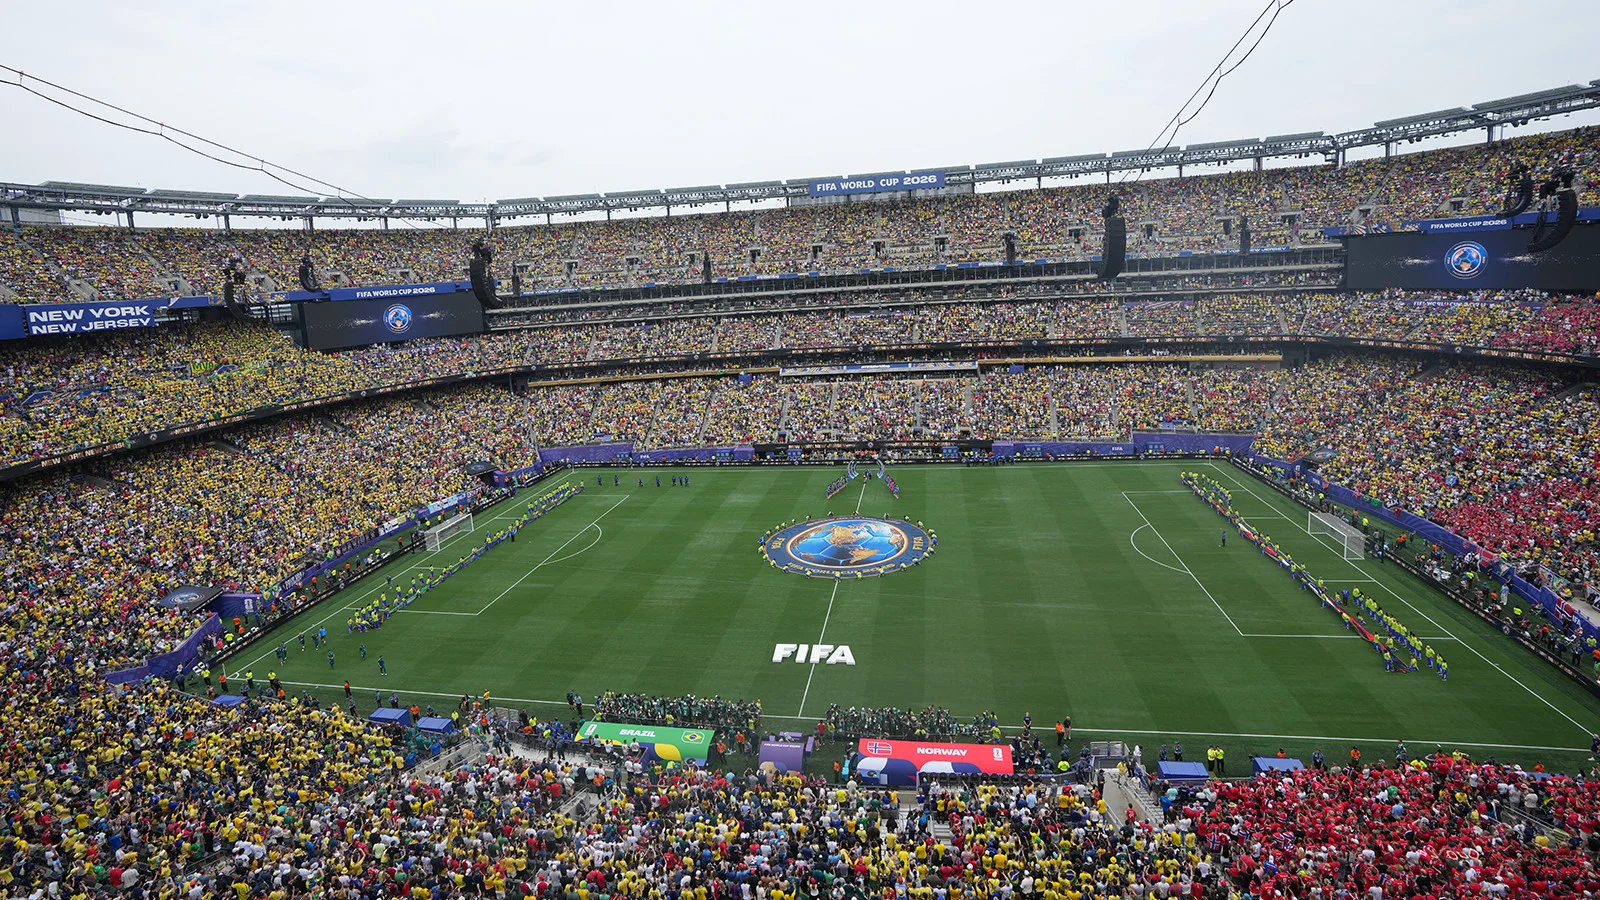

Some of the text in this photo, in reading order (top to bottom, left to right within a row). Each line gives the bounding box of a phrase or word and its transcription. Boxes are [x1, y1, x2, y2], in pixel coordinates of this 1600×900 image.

[817, 175, 937, 191] FIFA WORLD CUP 2026
[29, 305, 150, 323] NEW YORK
[32, 318, 151, 335] NEW JERSEY
[40, 457, 61, 468] NEW
[84, 446, 103, 456] NEW
[912, 536, 923, 550] FIFA
[772, 643, 856, 666] FIFA
[620, 729, 656, 737] BRAZIL
[916, 747, 968, 756] NORWAY
